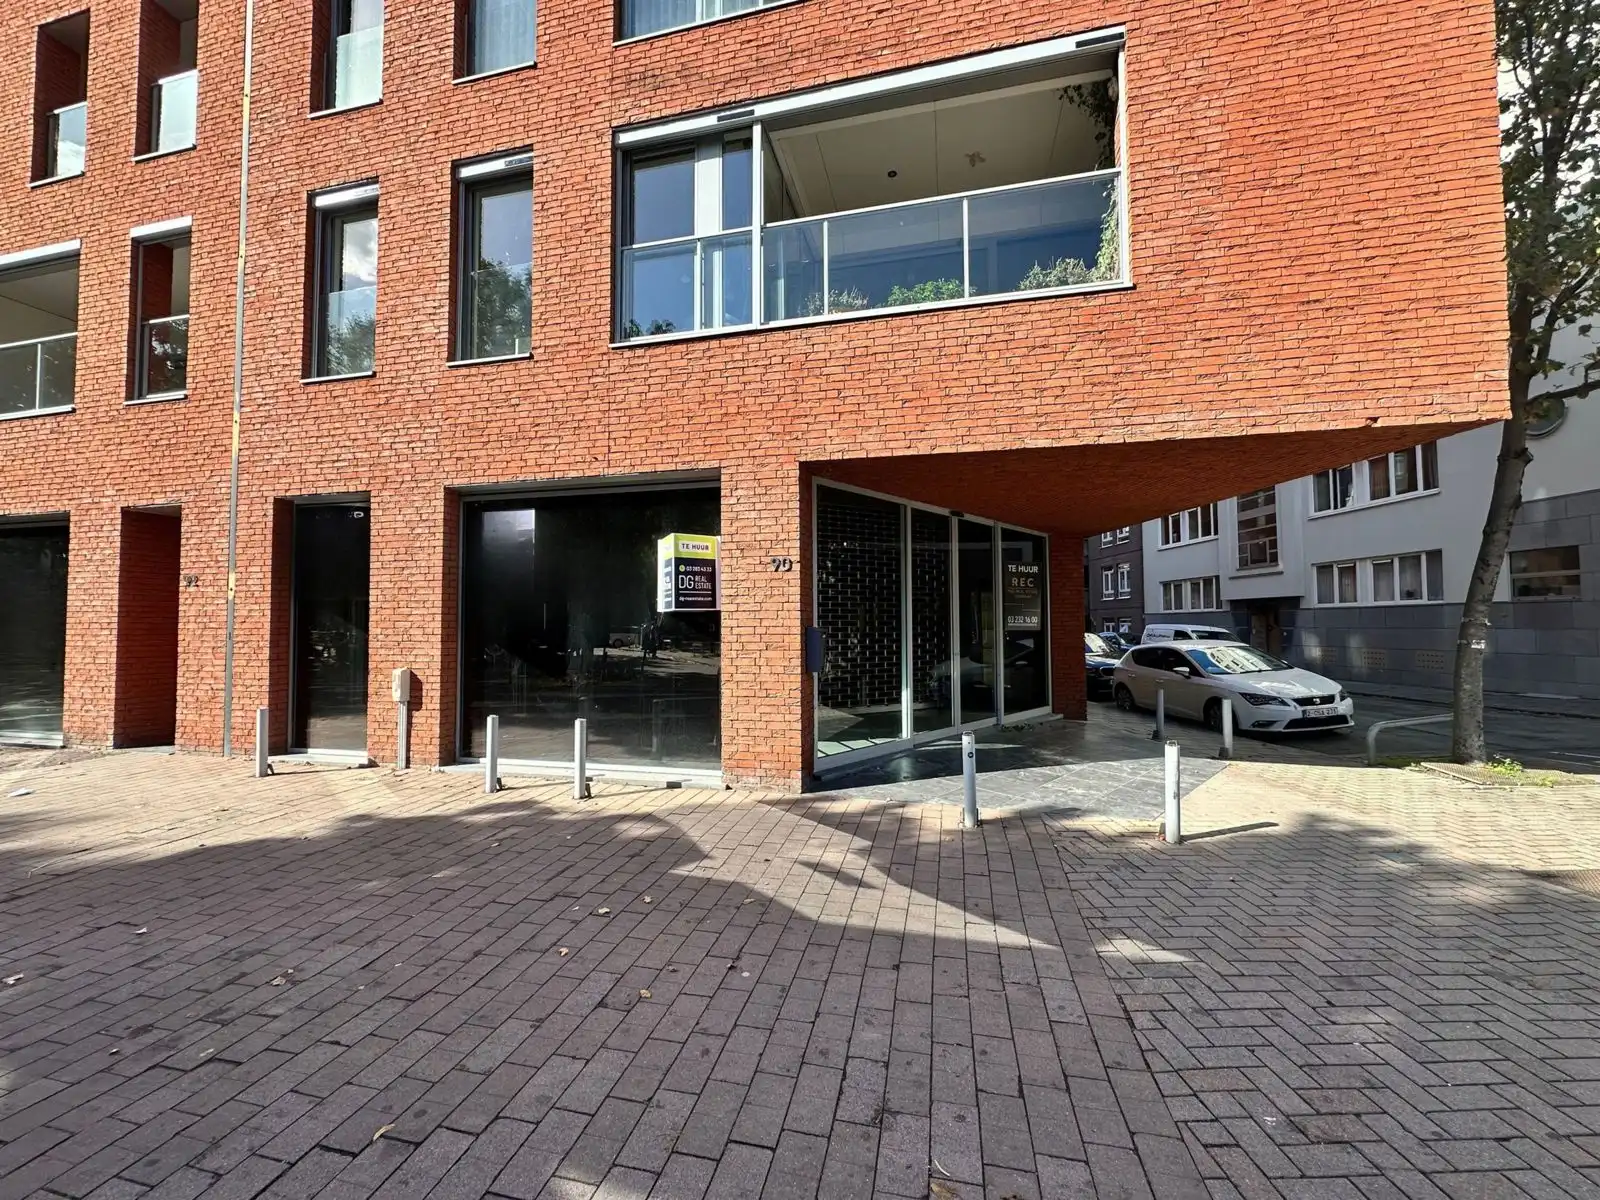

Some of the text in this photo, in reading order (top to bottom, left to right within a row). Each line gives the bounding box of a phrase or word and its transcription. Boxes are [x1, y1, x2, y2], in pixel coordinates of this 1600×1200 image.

[770, 557, 793, 572] 90
[679, 575, 694, 589] DG
[1007, 615, 1015, 623] 03
